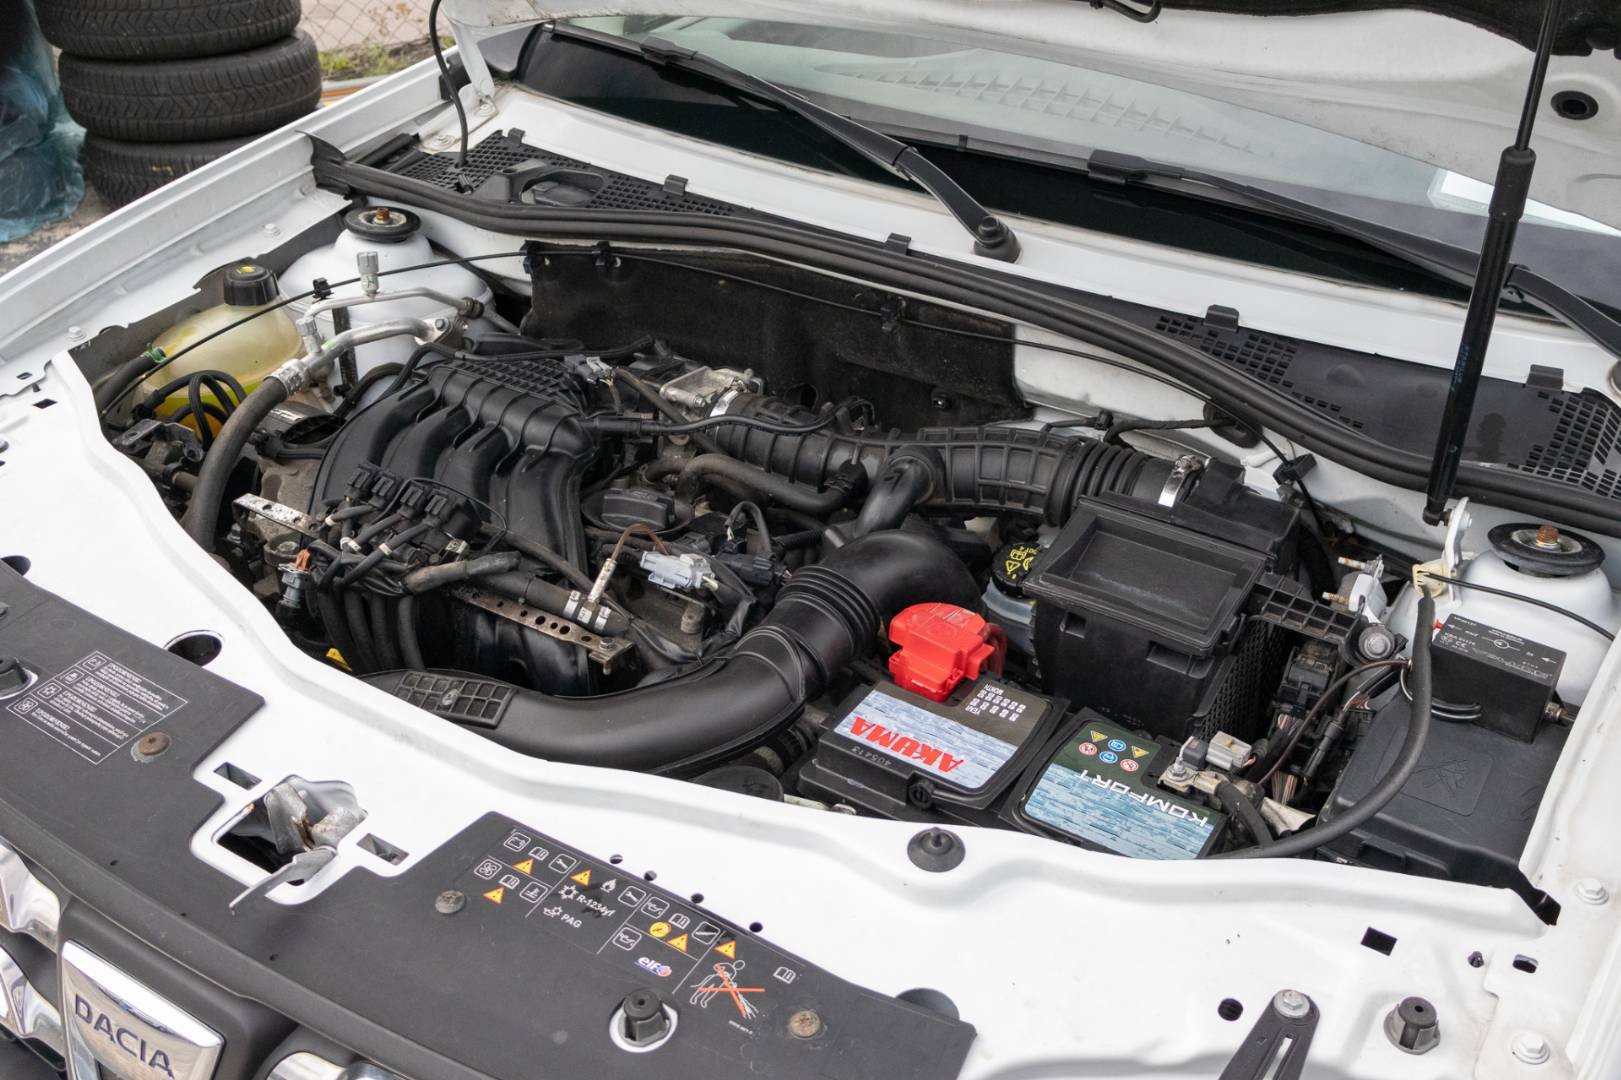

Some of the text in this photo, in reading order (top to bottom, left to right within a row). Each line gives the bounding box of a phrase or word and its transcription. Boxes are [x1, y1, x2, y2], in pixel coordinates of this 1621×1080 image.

[984, 684, 1004, 695] MONTH
[965, 705, 982, 716] YEAR
[849, 716, 964, 773] AKUMA
[1076, 770, 1209, 827] KOMFORT
[576, 894, 616, 918] R-1234yf
[561, 914, 582, 928] PAG
[75, 993, 175, 1079] DACIA
